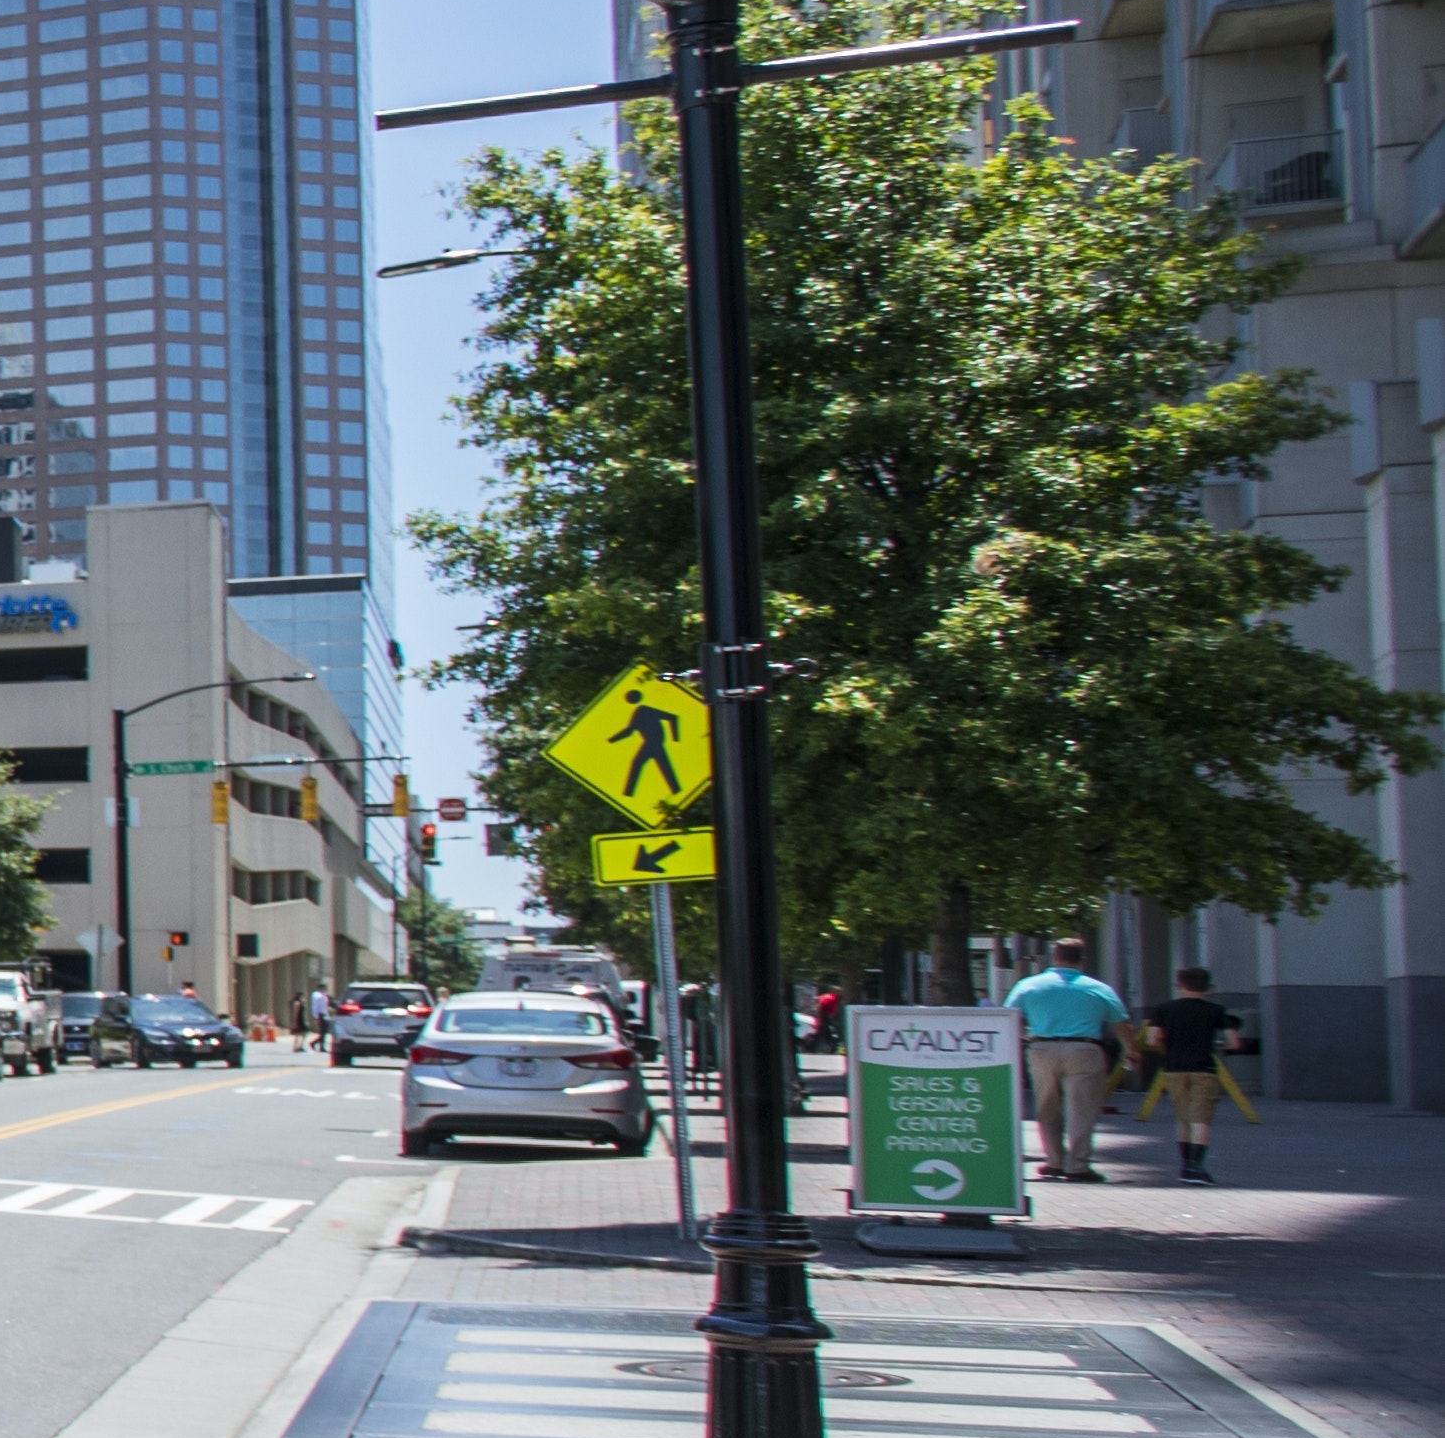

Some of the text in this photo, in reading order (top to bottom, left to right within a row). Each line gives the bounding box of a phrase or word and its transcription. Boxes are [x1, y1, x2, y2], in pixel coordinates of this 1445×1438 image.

[867, 1021, 1000, 1053] CATALYST
[889, 1076, 981, 1093] SALES &
[888, 1096, 984, 1113] LEASING
[896, 1116, 979, 1133] CENTER
[885, 1136, 989, 1154] PARKING
